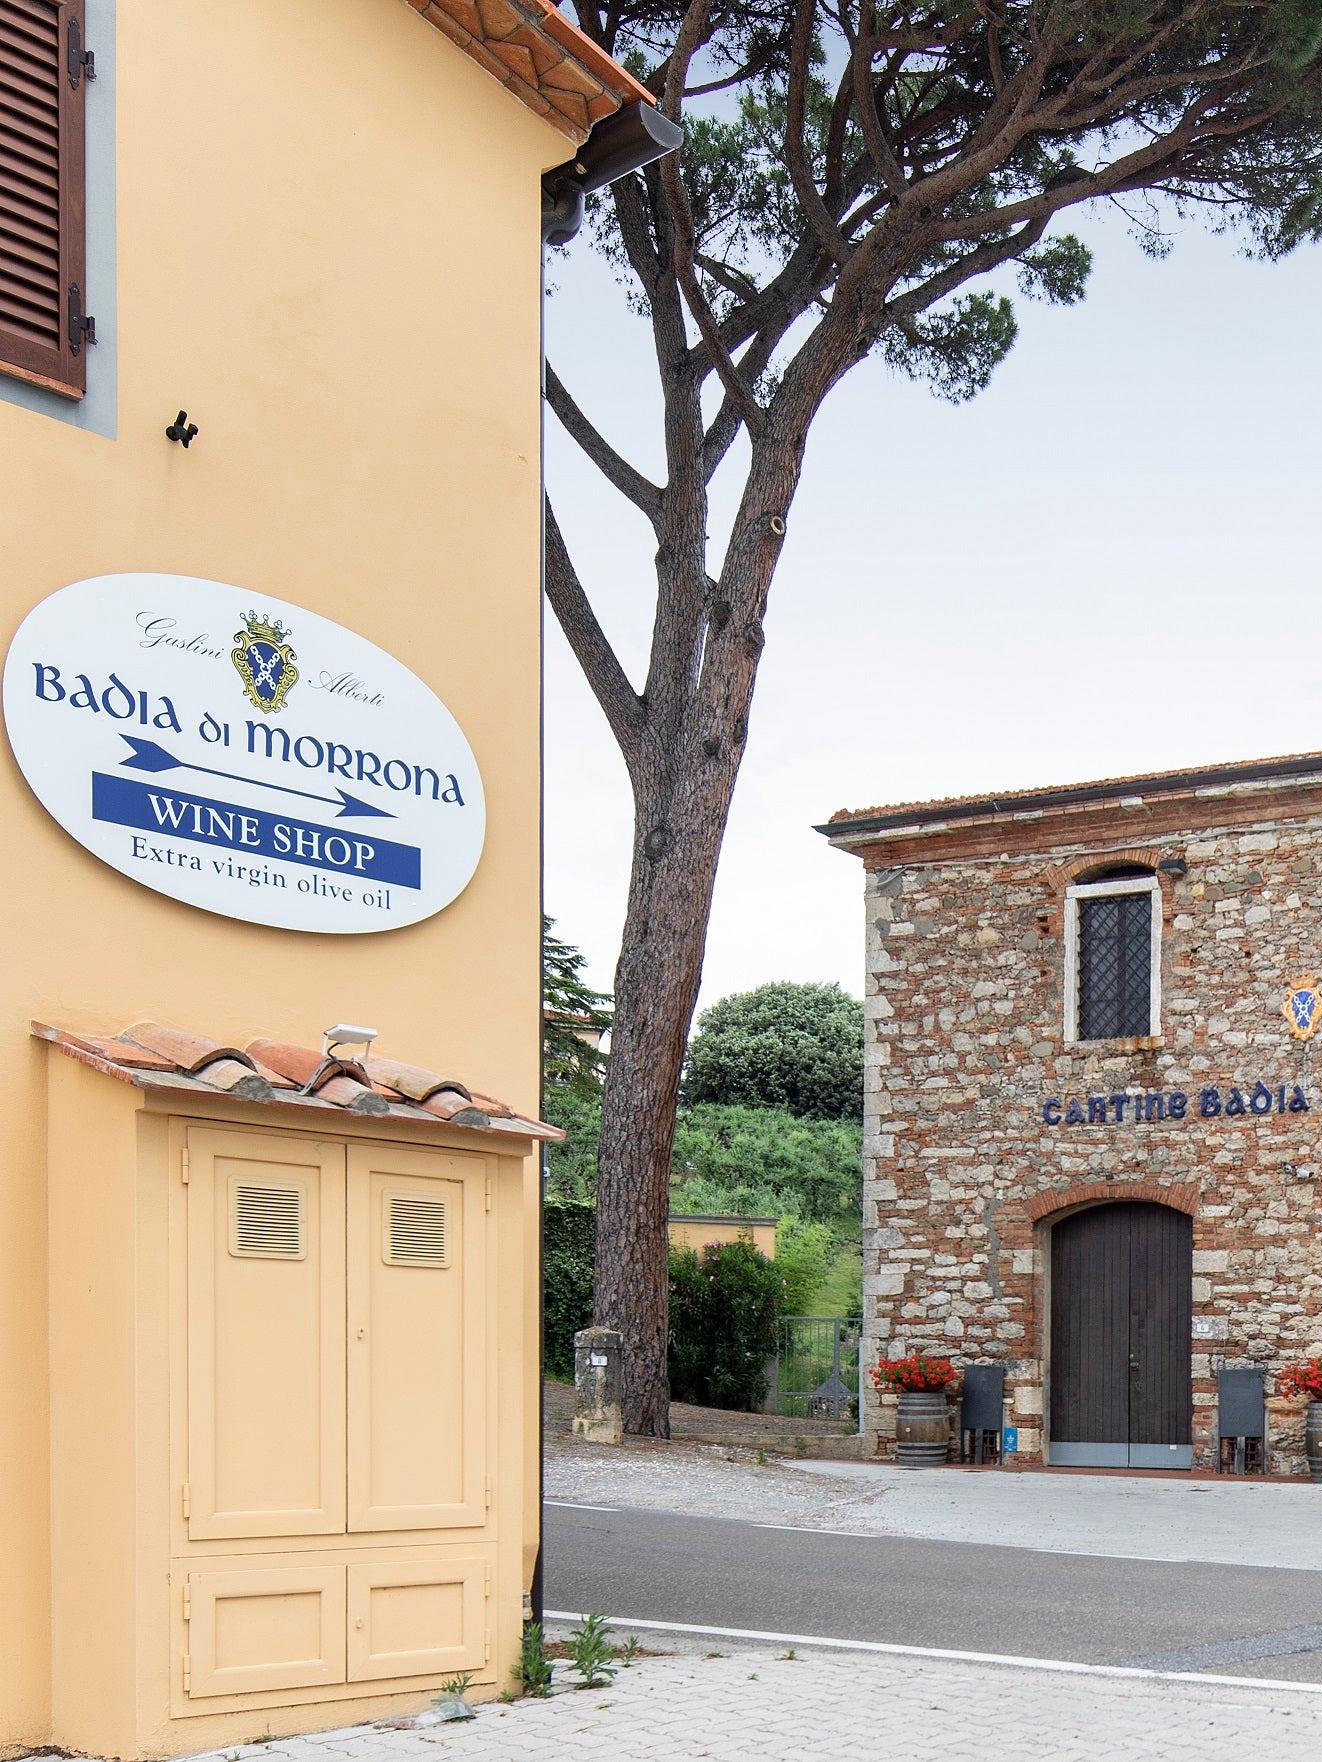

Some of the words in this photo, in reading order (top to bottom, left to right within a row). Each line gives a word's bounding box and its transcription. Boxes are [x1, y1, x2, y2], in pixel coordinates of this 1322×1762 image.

[135, 611, 227, 661] Gaslini
[308, 670, 386, 708] Alberti
[147, 794, 261, 848] WINE
[273, 823, 375, 872] SHOP
[130, 835, 203, 873] Extra
[212, 857, 287, 889] virgin
[296, 873, 354, 903] olive
[361, 890, 392, 912] oil
